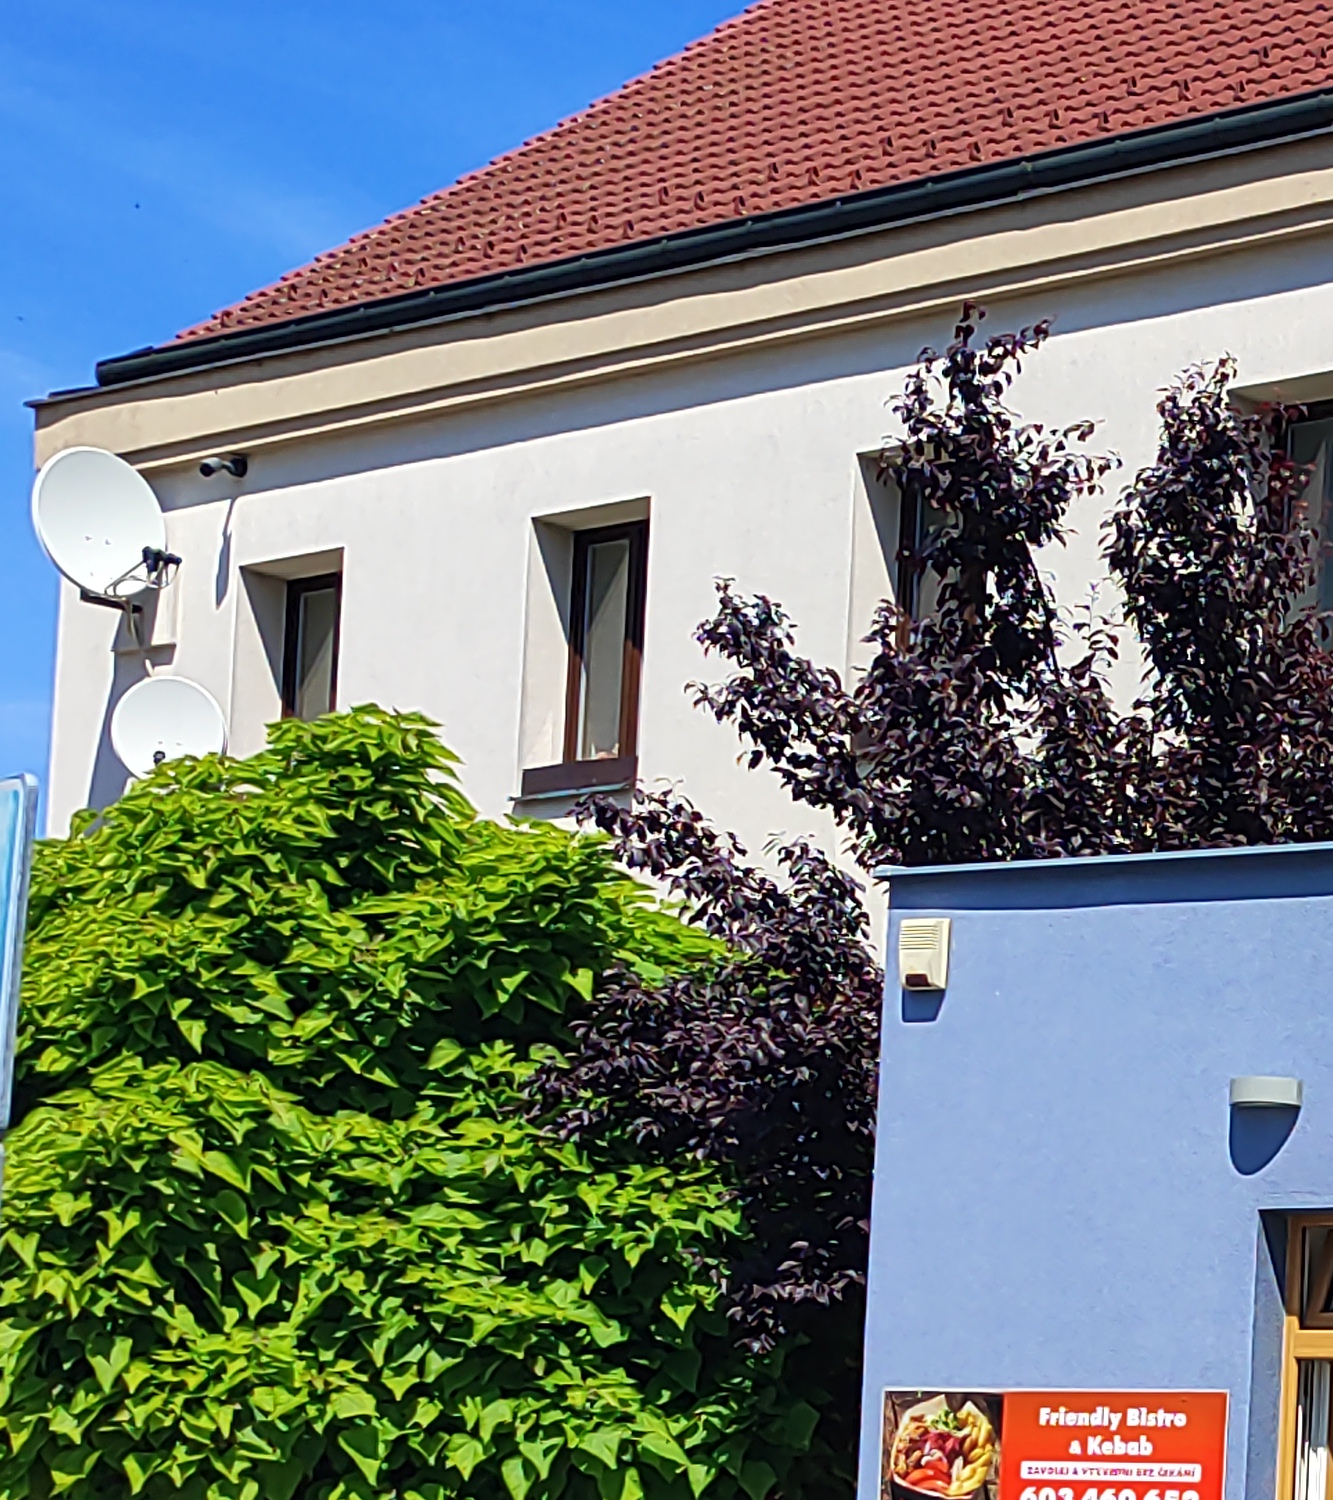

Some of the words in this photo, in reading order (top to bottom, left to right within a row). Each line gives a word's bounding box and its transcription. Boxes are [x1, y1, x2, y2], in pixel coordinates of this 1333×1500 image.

[1039, 1406, 1122, 1431] Friendly
[1126, 1406, 1187, 1428] Bistro
[1087, 1434, 1153, 1456] Kebab
